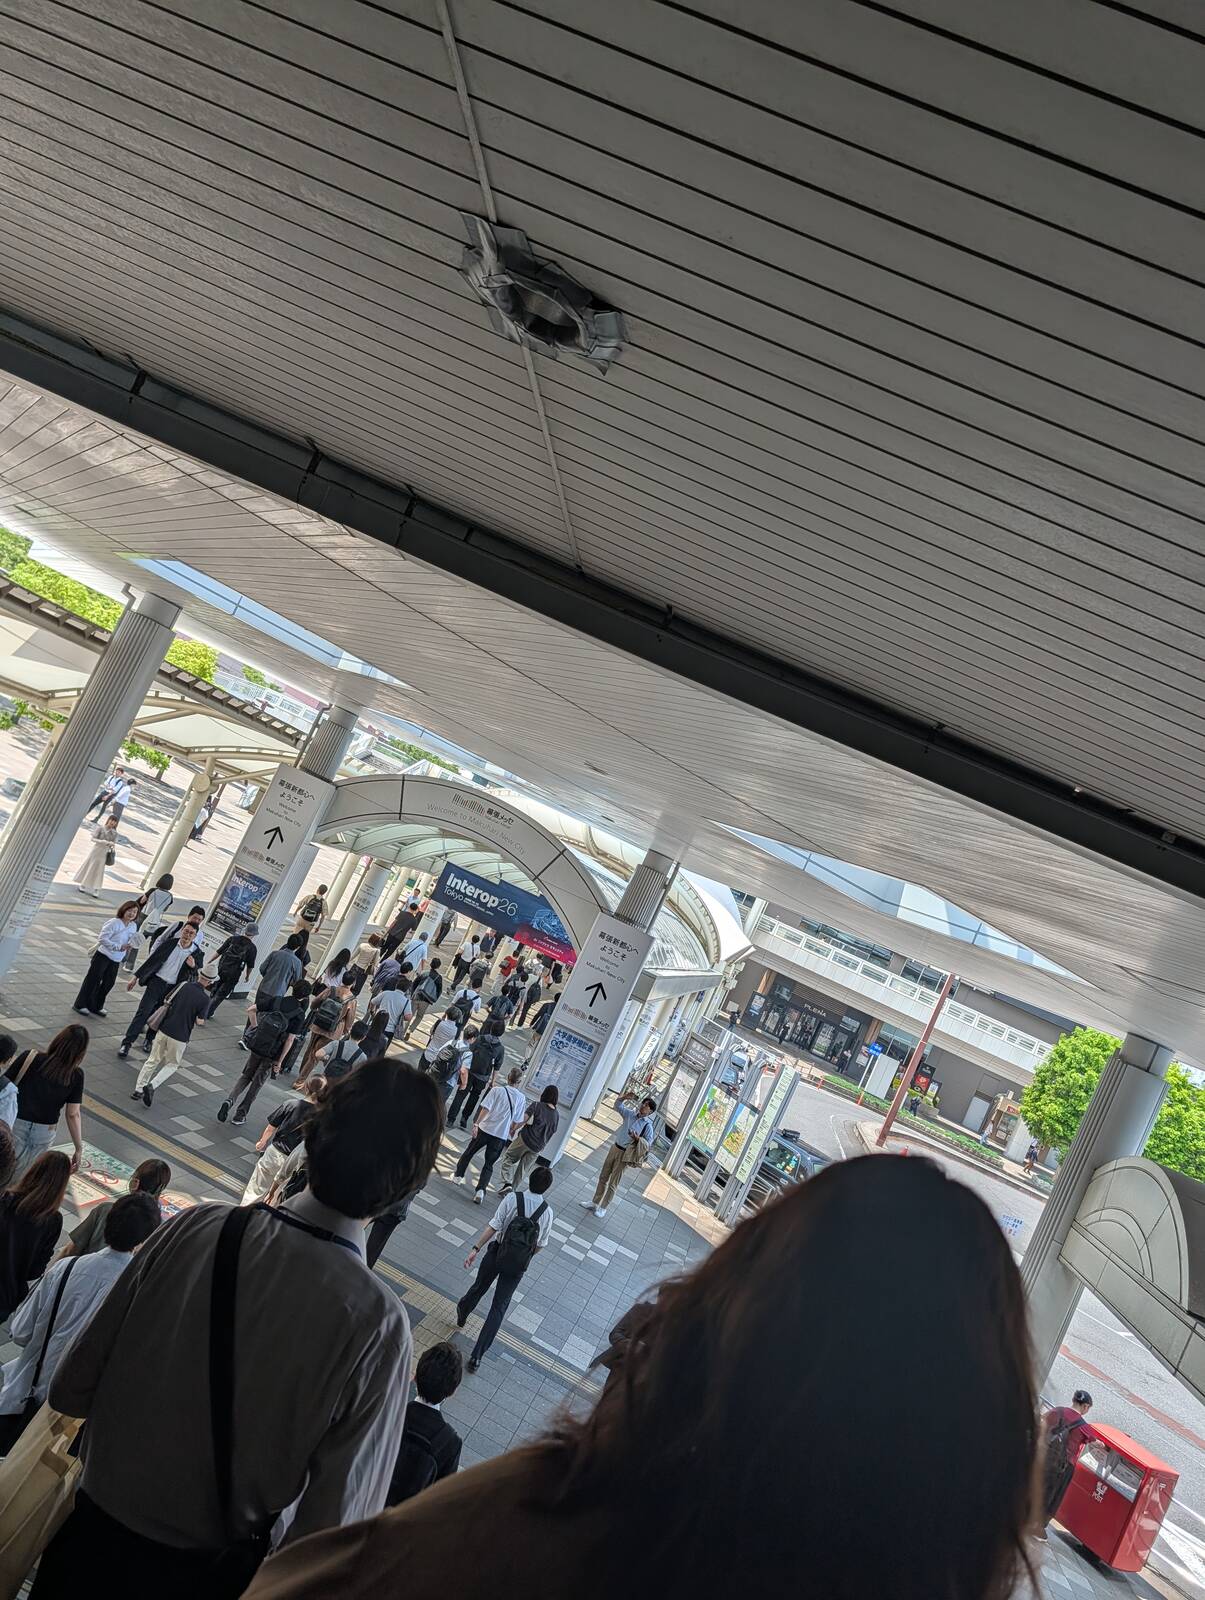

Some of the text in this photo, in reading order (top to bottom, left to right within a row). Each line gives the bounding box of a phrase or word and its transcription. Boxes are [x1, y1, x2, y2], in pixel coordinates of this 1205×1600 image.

[278, 779, 315, 801] 幕張新都心へ
[280, 791, 304, 807] ようこそ
[426, 803, 458, 817] Welcome
[486, 808, 514, 825] 幕張メッセ
[444, 886, 464, 901] Tokyo
[598, 931, 639, 955] 幕張新都心へ
[600, 945, 628, 962] ようこそ
